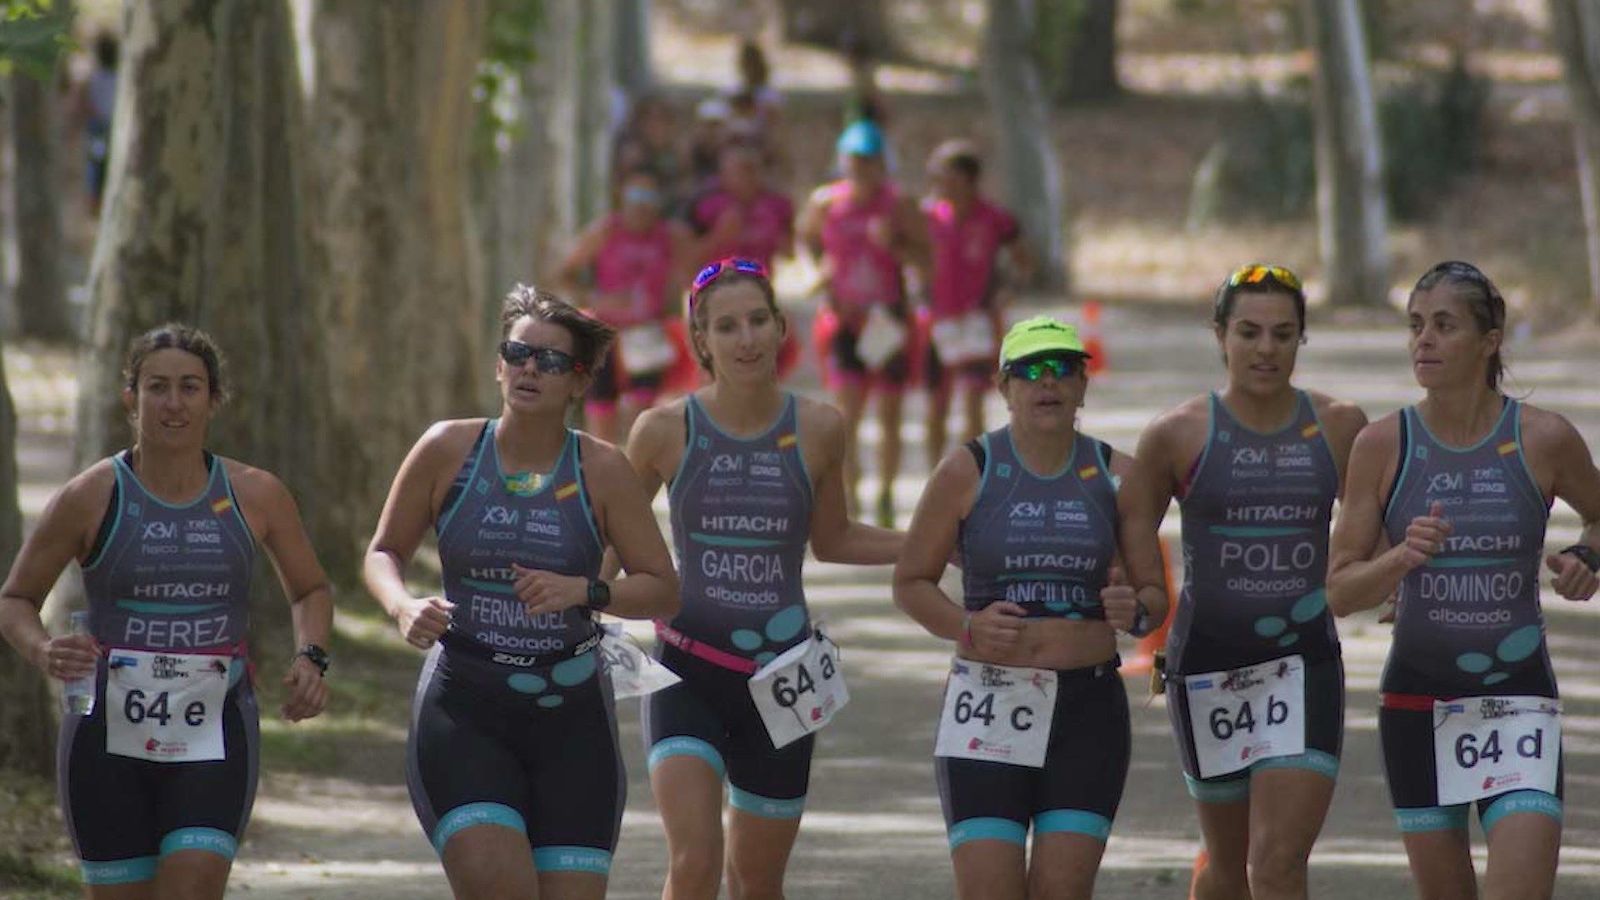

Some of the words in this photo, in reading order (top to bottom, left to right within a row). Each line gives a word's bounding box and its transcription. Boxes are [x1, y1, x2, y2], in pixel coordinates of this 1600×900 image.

[702, 516, 788, 532] HITACHI
[1226, 505, 1318, 521] HITACHI
[702, 550, 784, 584] GARCIA
[1005, 554, 1097, 571] HITACHI
[1220, 542, 1315, 572] POLO
[133, 583, 230, 598] HITACHI
[1420, 571, 1523, 602] DOMINGO
[124, 615, 230, 648] PEREZ
[476, 630, 565, 651] alborada
[771, 664, 815, 708] 64
[820, 653, 836, 679] a
[124, 688, 171, 727] 64
[184, 700, 206, 727] e
[954, 690, 996, 726] 64
[1010, 705, 1034, 731] c
[1210, 701, 1255, 740] 64
[1267, 694, 1288, 727] b
[1455, 729, 1502, 769] 64
[1516, 727, 1543, 760] d
